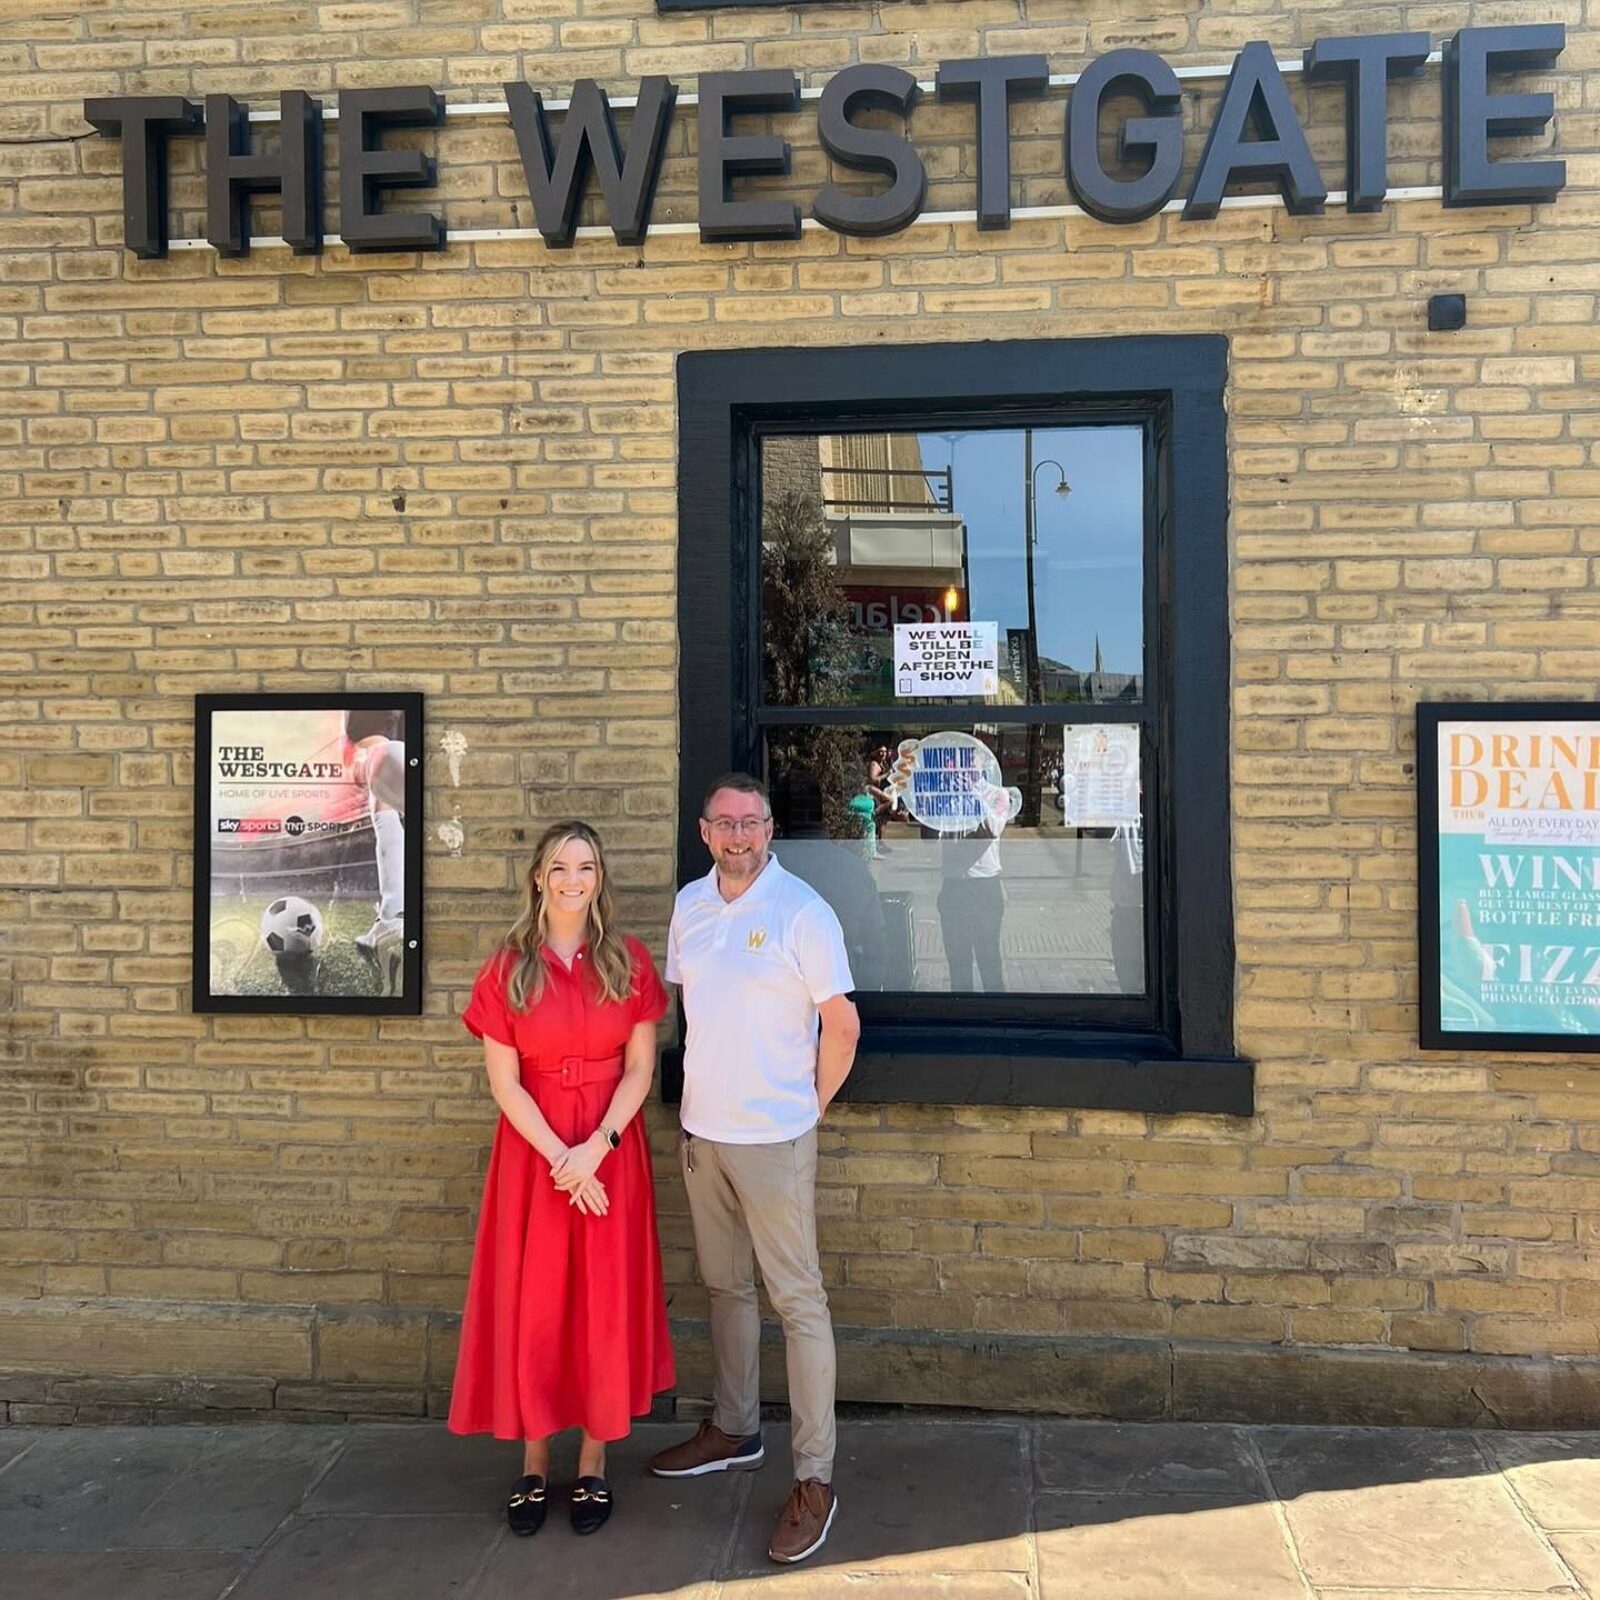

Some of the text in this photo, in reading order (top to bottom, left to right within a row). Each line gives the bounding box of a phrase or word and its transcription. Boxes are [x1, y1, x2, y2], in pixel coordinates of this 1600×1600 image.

[84, 23, 1565, 258] THE WESTGATE
[908, 630, 983, 640] WE WILL
[908, 640, 983, 650] STILL BE
[921, 651, 970, 660] OPEN
[900, 660, 994, 671] AFTER THE
[920, 671, 973, 681] SHOW
[218, 746, 264, 761] THE
[923, 747, 977, 769] WATCH THE
[218, 763, 343, 778] WESTGATE
[913, 770, 959, 793] WOMEN'S
[219, 789, 330, 799] HOME OF LIVE SPORTS
[915, 795, 960, 817] MATCHES
[220, 820, 280, 832] sky sports
[307, 822, 348, 832] SPORTS
[1488, 817, 1599, 829] ALL DAY EVERY DAY
[1478, 854, 1600, 891] WIN
[1479, 889, 1501, 898] BUY
[1506, 889, 1513, 898] 2
[1515, 889, 1557, 899] LARGE
[1479, 899, 1502, 908] GET
[1508, 900, 1534, 909] THE
[1573, 901, 1589, 911] OF
[1479, 910, 1560, 925] BOTTLE
[1480, 983, 1529, 993] BOTTLE
[1480, 993, 1560, 1005] PROSECCO
